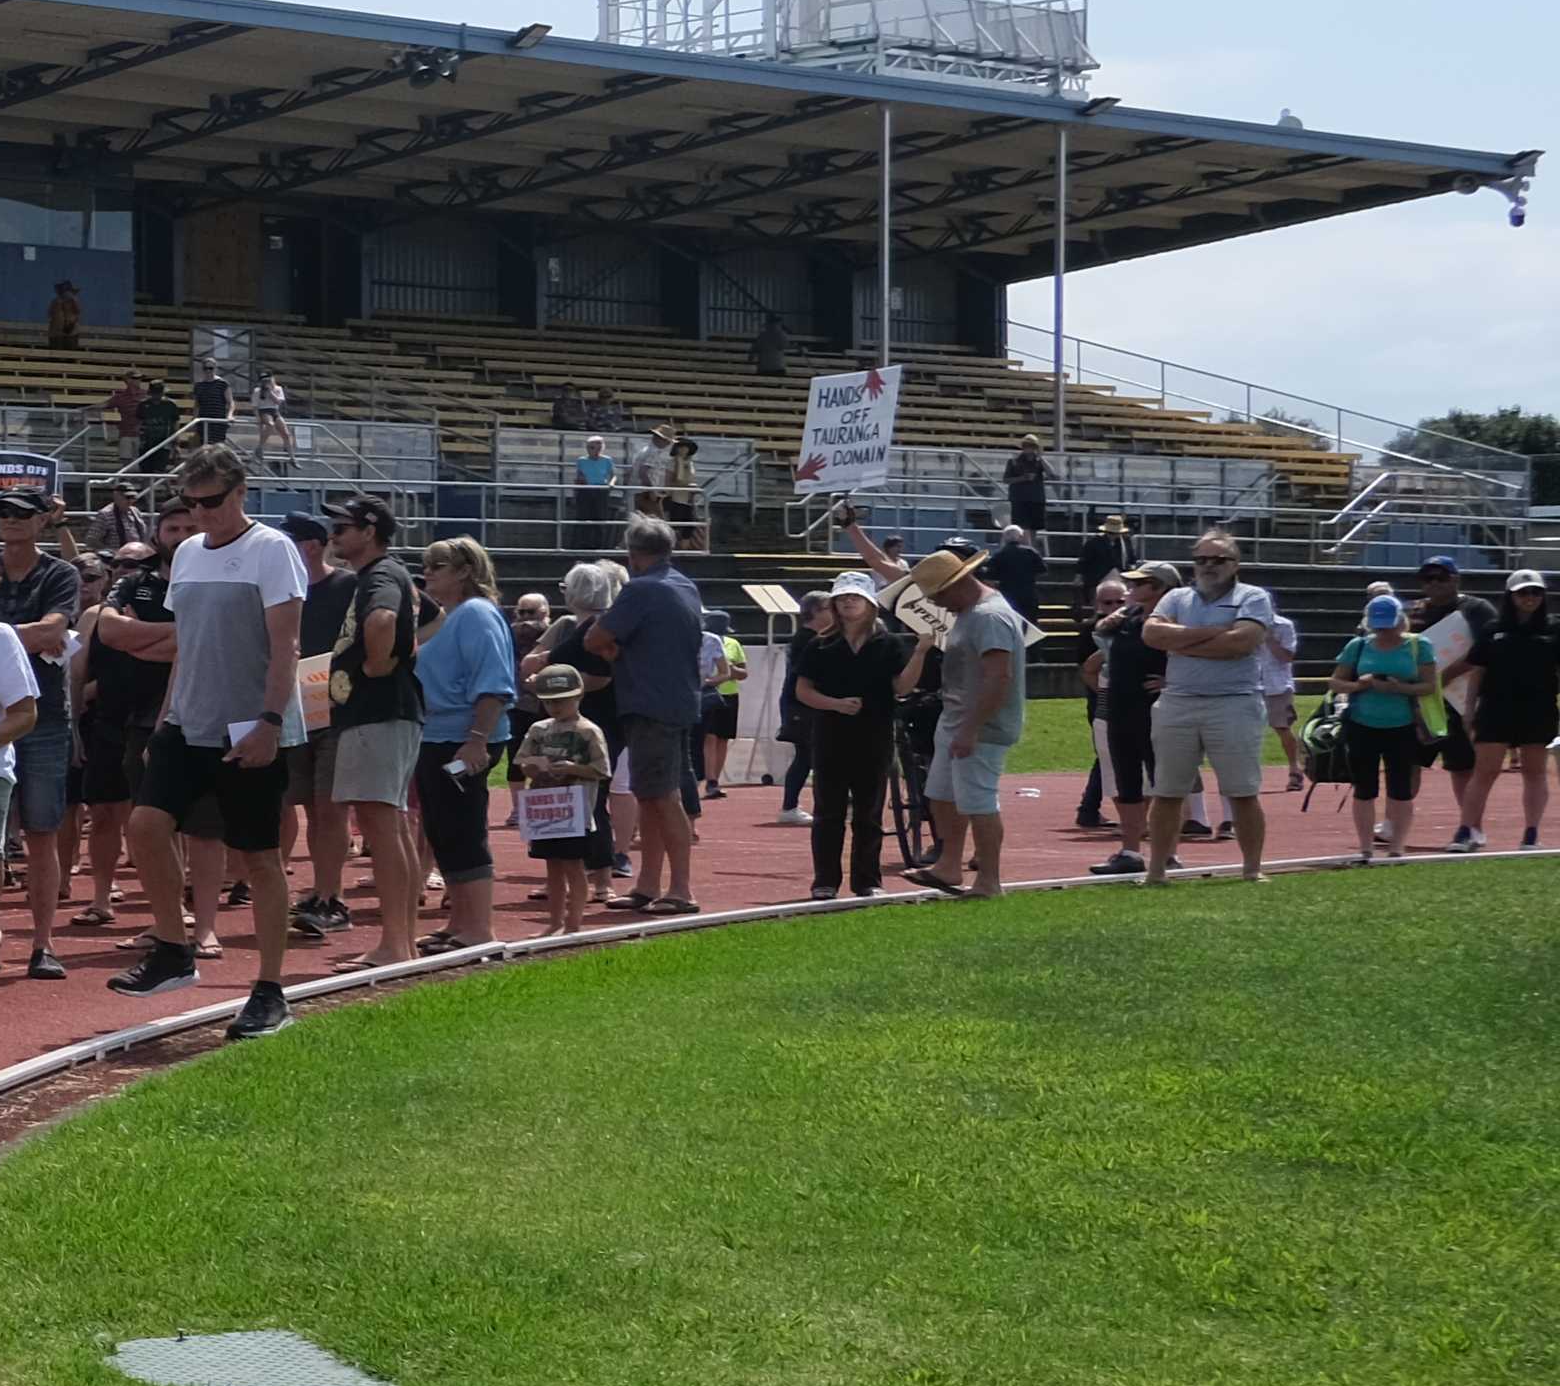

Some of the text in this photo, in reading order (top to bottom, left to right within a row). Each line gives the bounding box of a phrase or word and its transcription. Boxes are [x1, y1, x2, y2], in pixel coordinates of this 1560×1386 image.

[817, 387, 864, 409] HANDS
[841, 408, 870, 423] OFF
[812, 423, 880, 446] TAURANGA
[832, 445, 886, 466] DOMAIN
